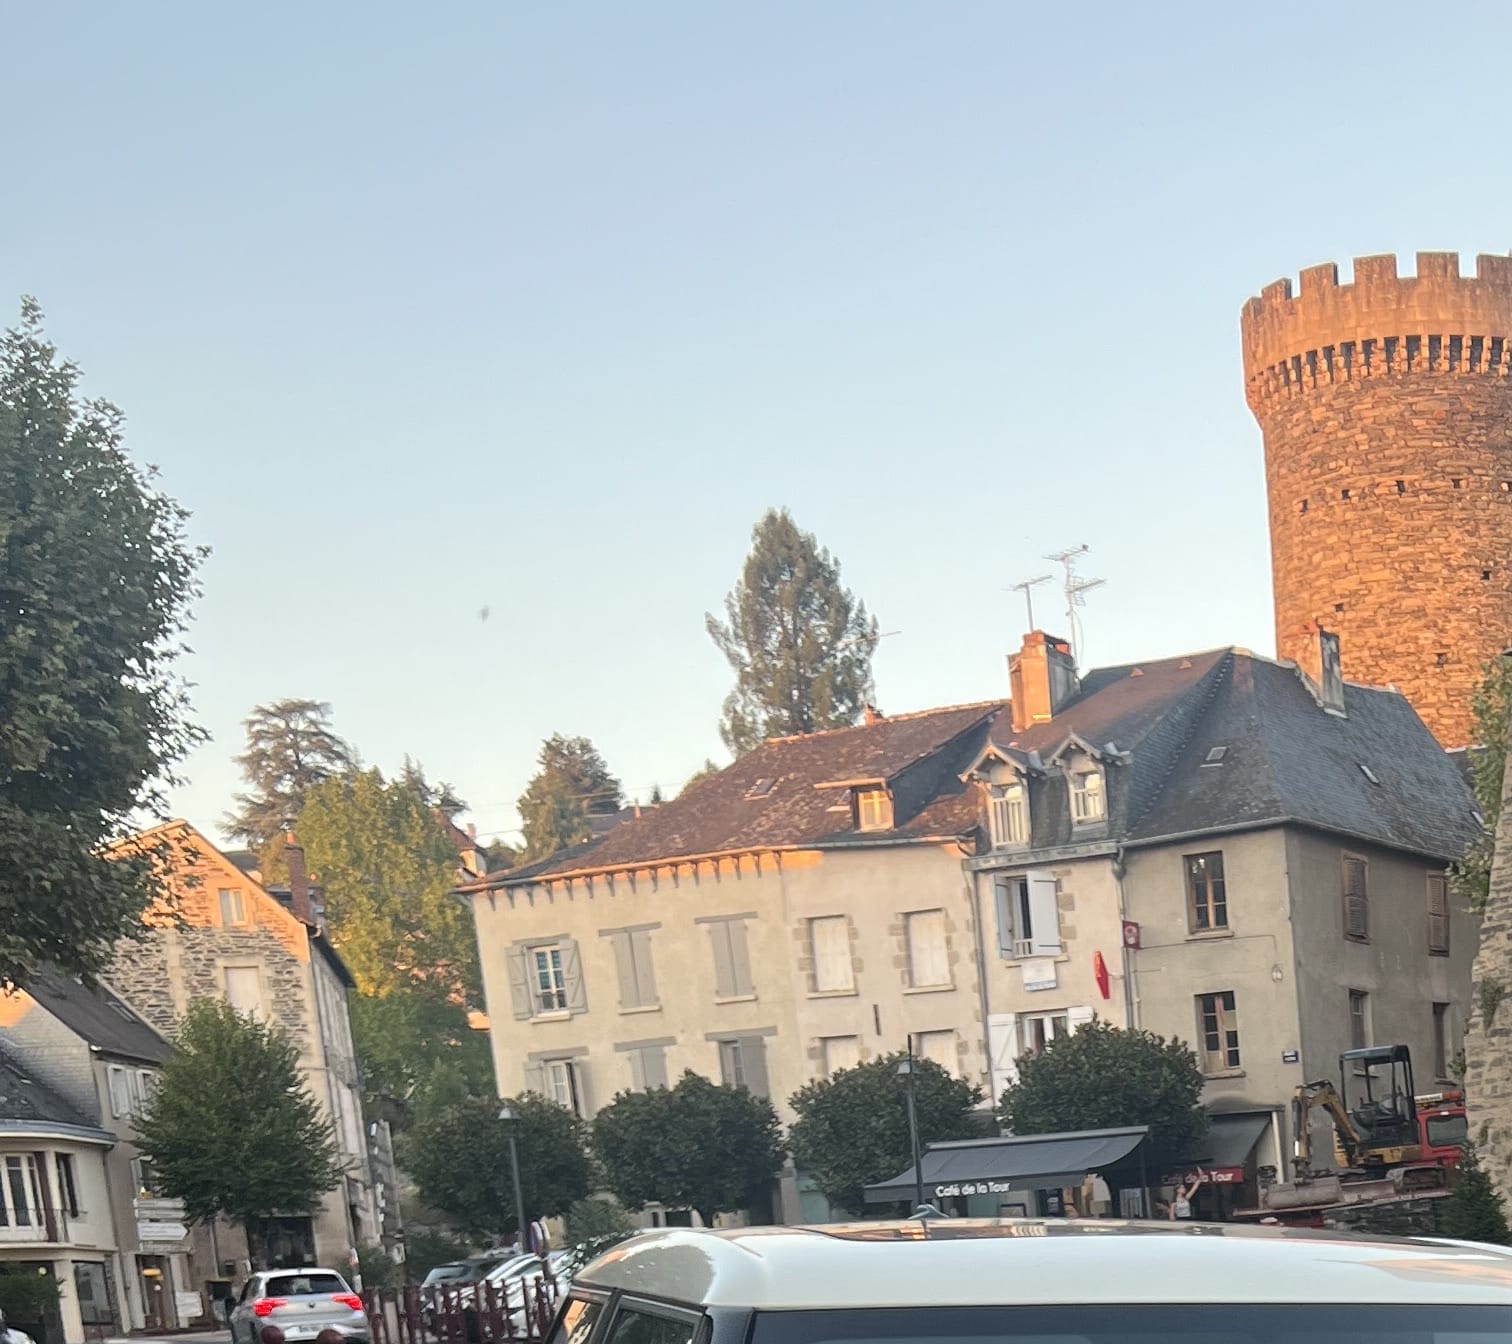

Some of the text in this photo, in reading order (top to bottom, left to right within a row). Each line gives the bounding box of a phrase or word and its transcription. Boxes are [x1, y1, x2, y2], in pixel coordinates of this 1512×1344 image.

[1209, 1171, 1234, 1182] Tour
[935, 1181, 1011, 1198] Café de la Tour
